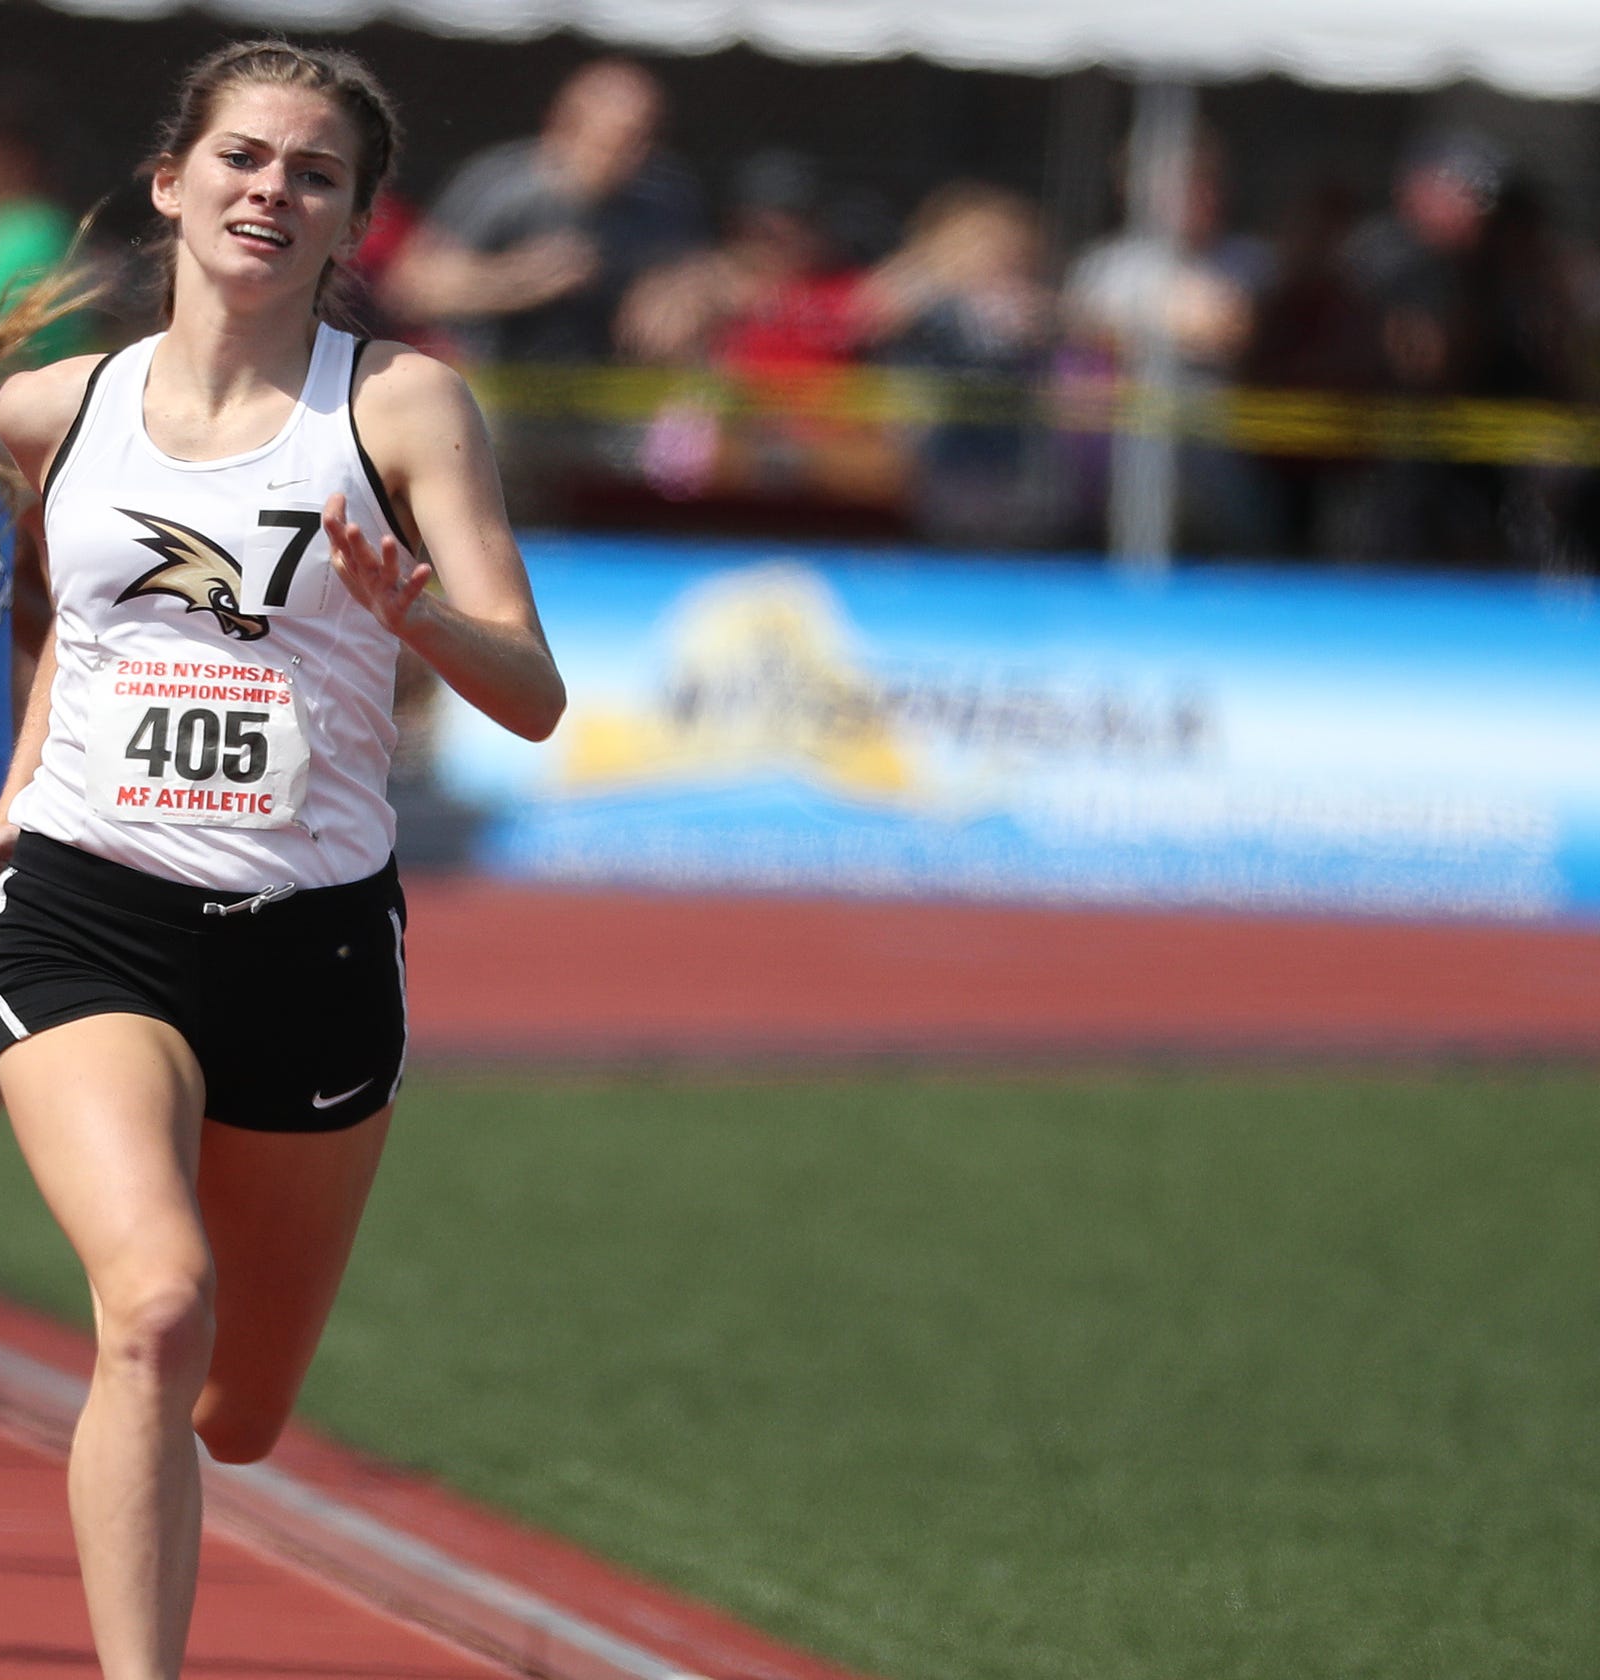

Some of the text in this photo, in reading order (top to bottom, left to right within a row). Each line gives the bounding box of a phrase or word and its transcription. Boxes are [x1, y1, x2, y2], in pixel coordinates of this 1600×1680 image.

[258, 510, 322, 607] 7
[117, 660, 290, 683] 2018 NYSPHSAA
[114, 681, 291, 705] CHAMPIONSHIPS
[125, 707, 269, 783] 405
[155, 788, 273, 815] ATHLETIC
